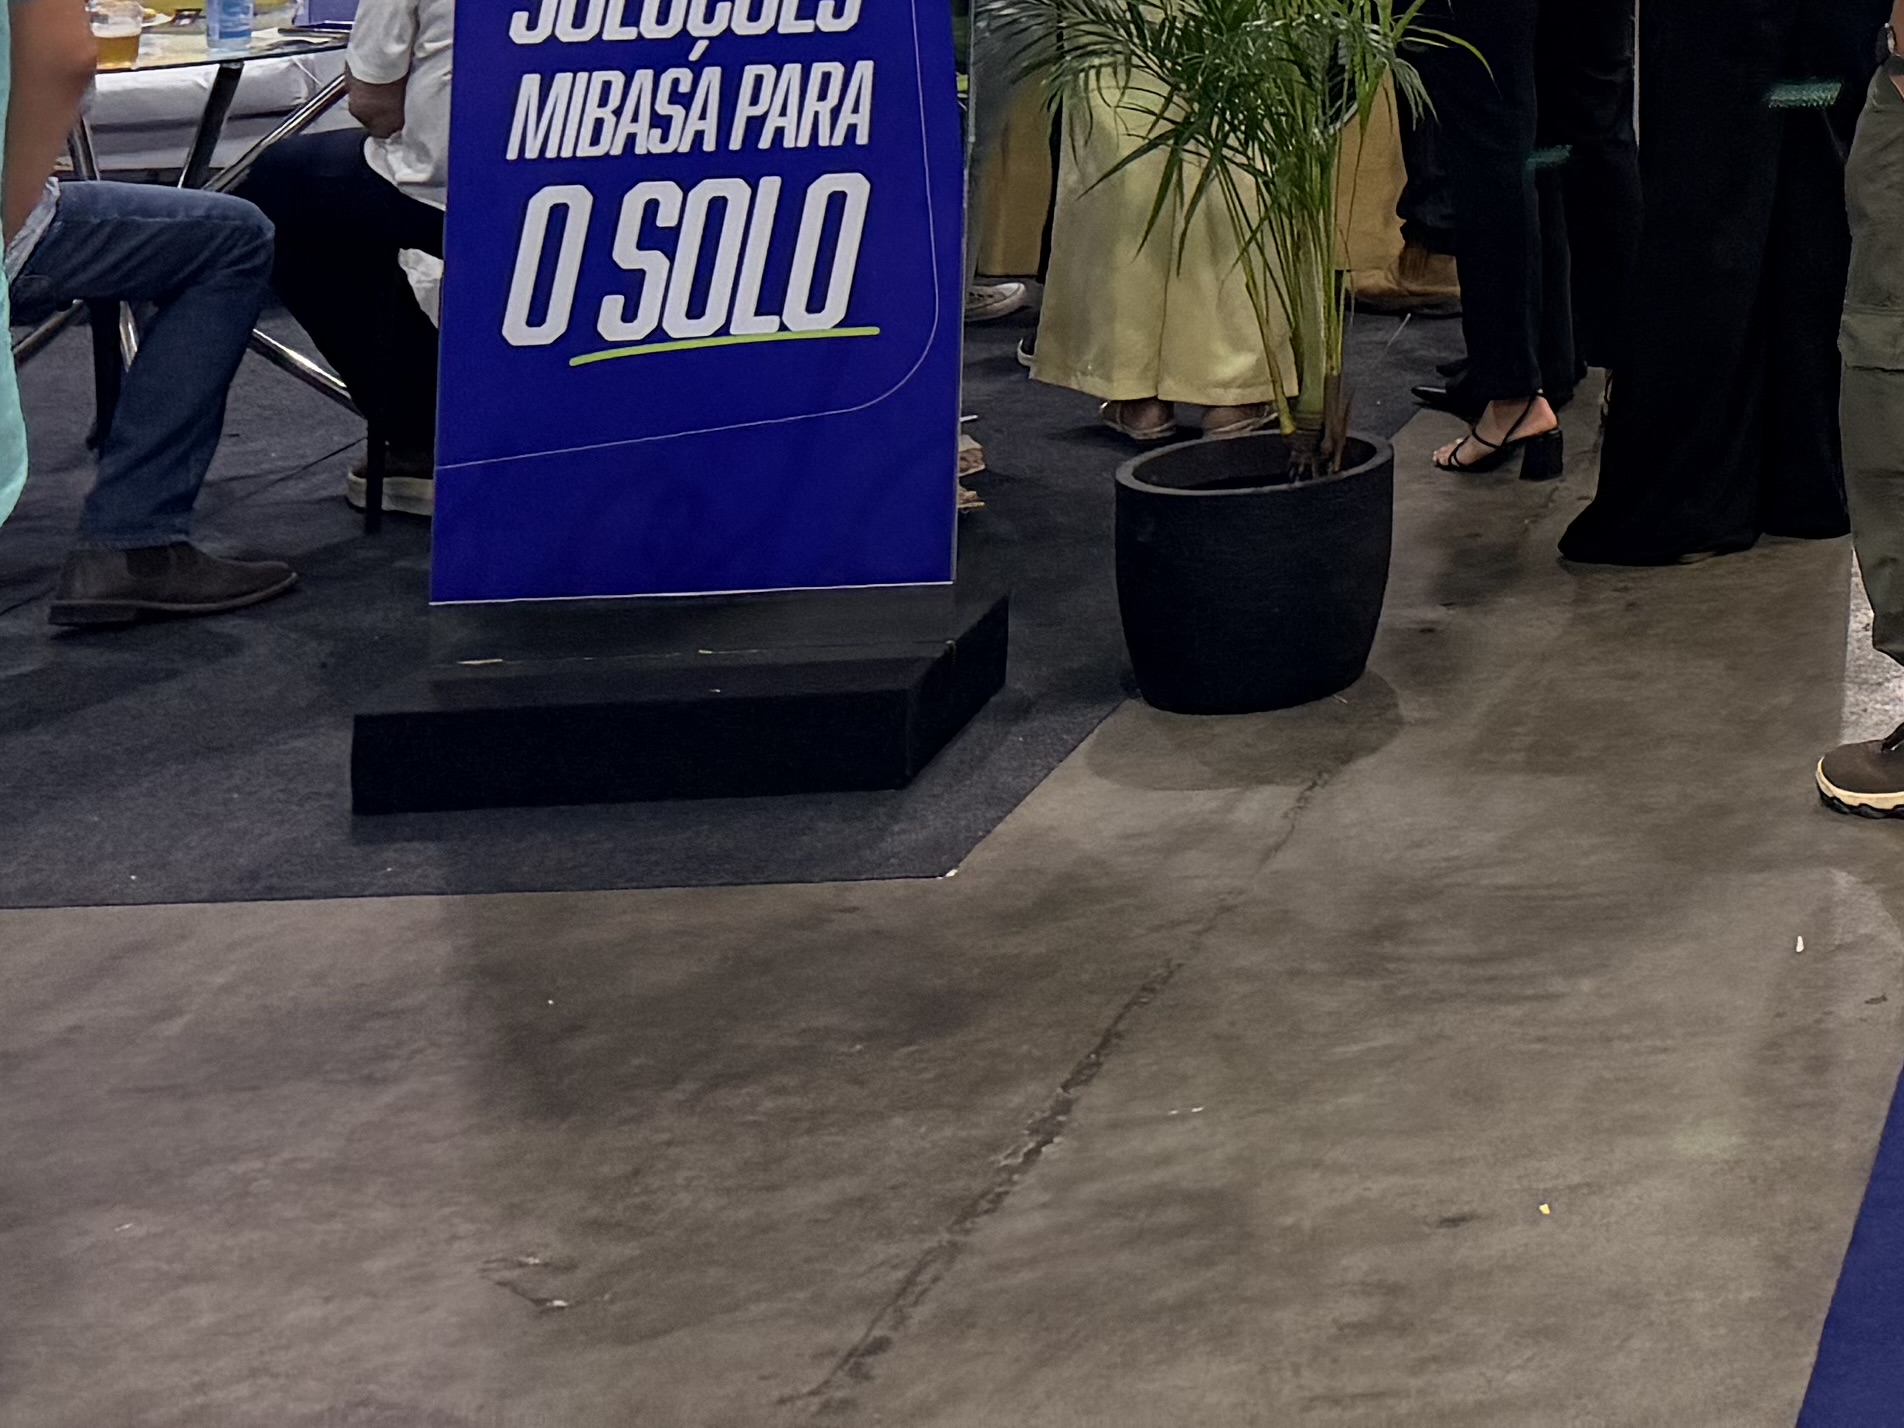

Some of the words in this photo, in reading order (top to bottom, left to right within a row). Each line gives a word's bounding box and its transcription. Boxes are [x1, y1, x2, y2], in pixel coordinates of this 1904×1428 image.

[506, 66, 723, 160] MIBASA
[728, 60, 875, 151] PARA
[501, 184, 594, 347] O
[596, 172, 872, 343] SOLO
